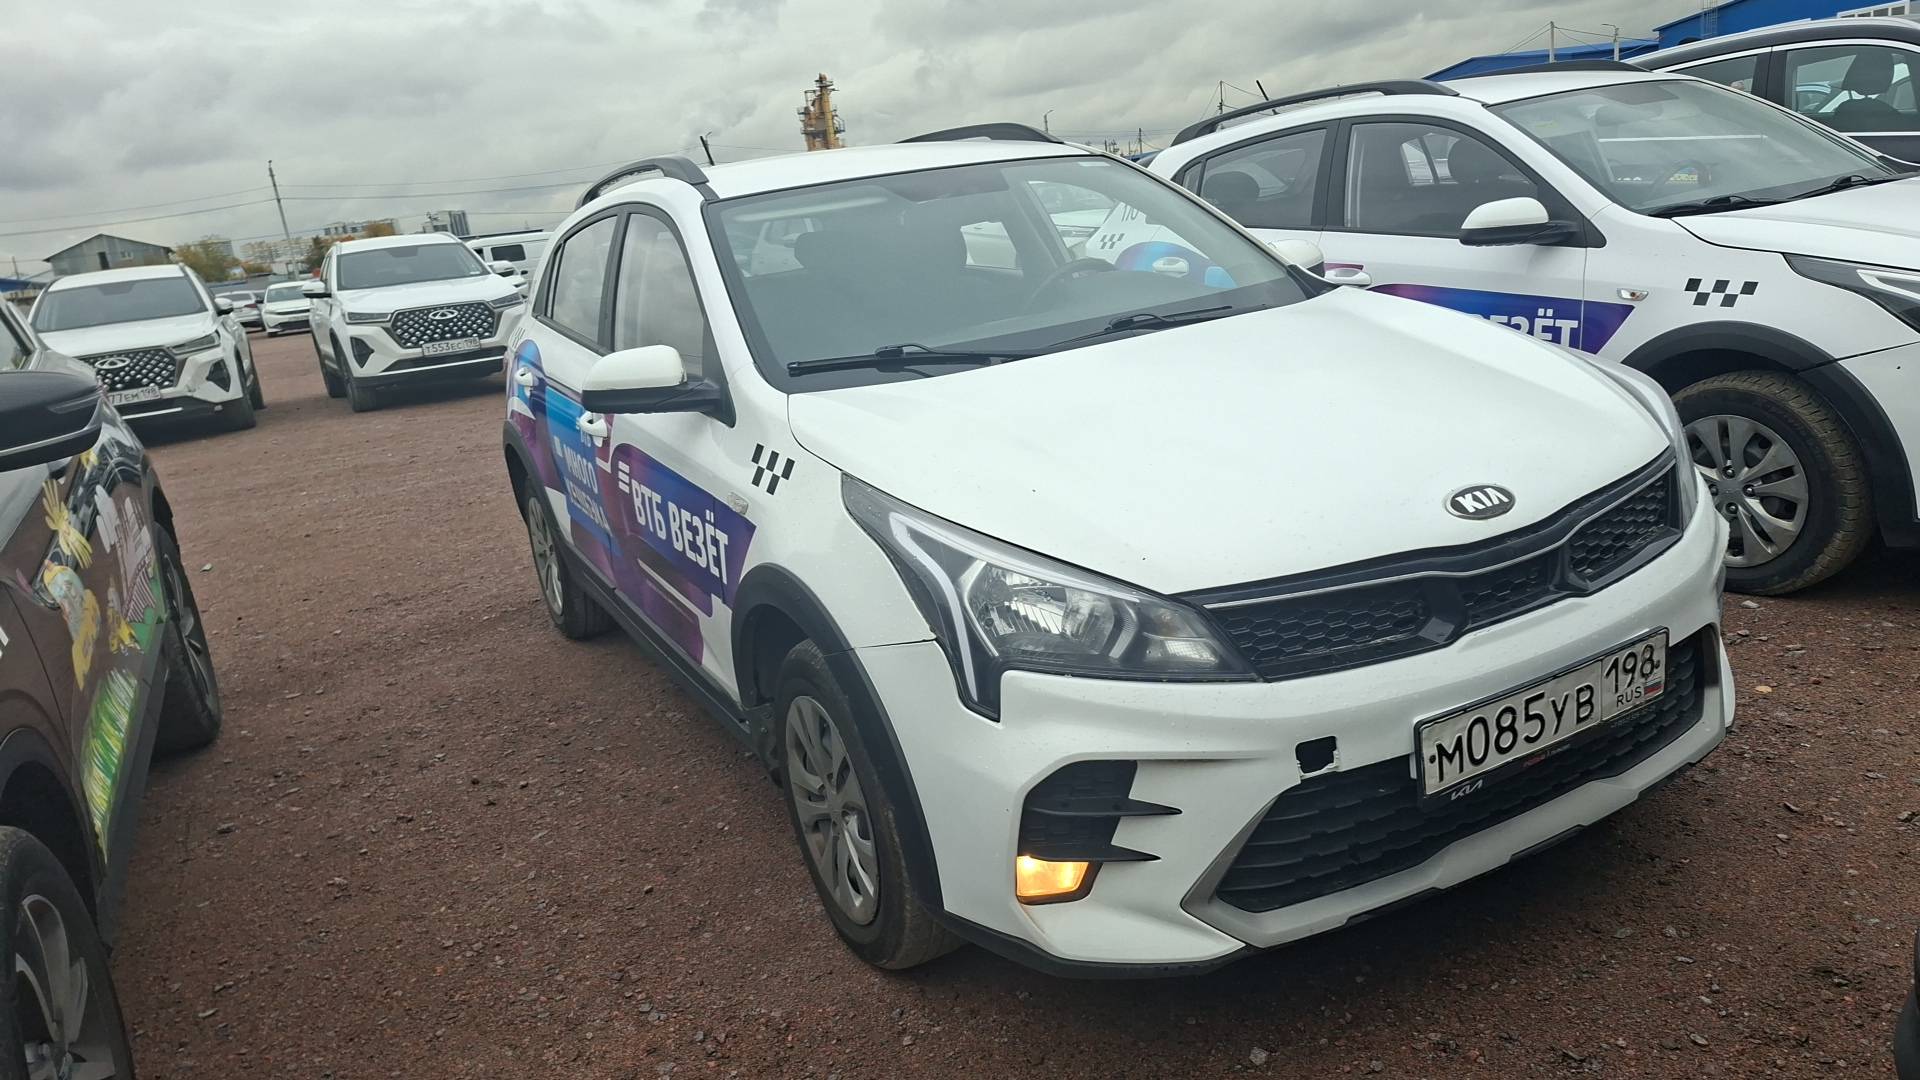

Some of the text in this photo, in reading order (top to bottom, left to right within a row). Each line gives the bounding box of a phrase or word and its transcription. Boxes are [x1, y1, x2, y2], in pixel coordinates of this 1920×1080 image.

[631, 478, 729, 585] ВТБ ВЕЗЁТ
[1455, 487, 1510, 513] KIA
[1435, 644, 1656, 783] М085УВ 198
[1616, 686, 1643, 708] RUS
